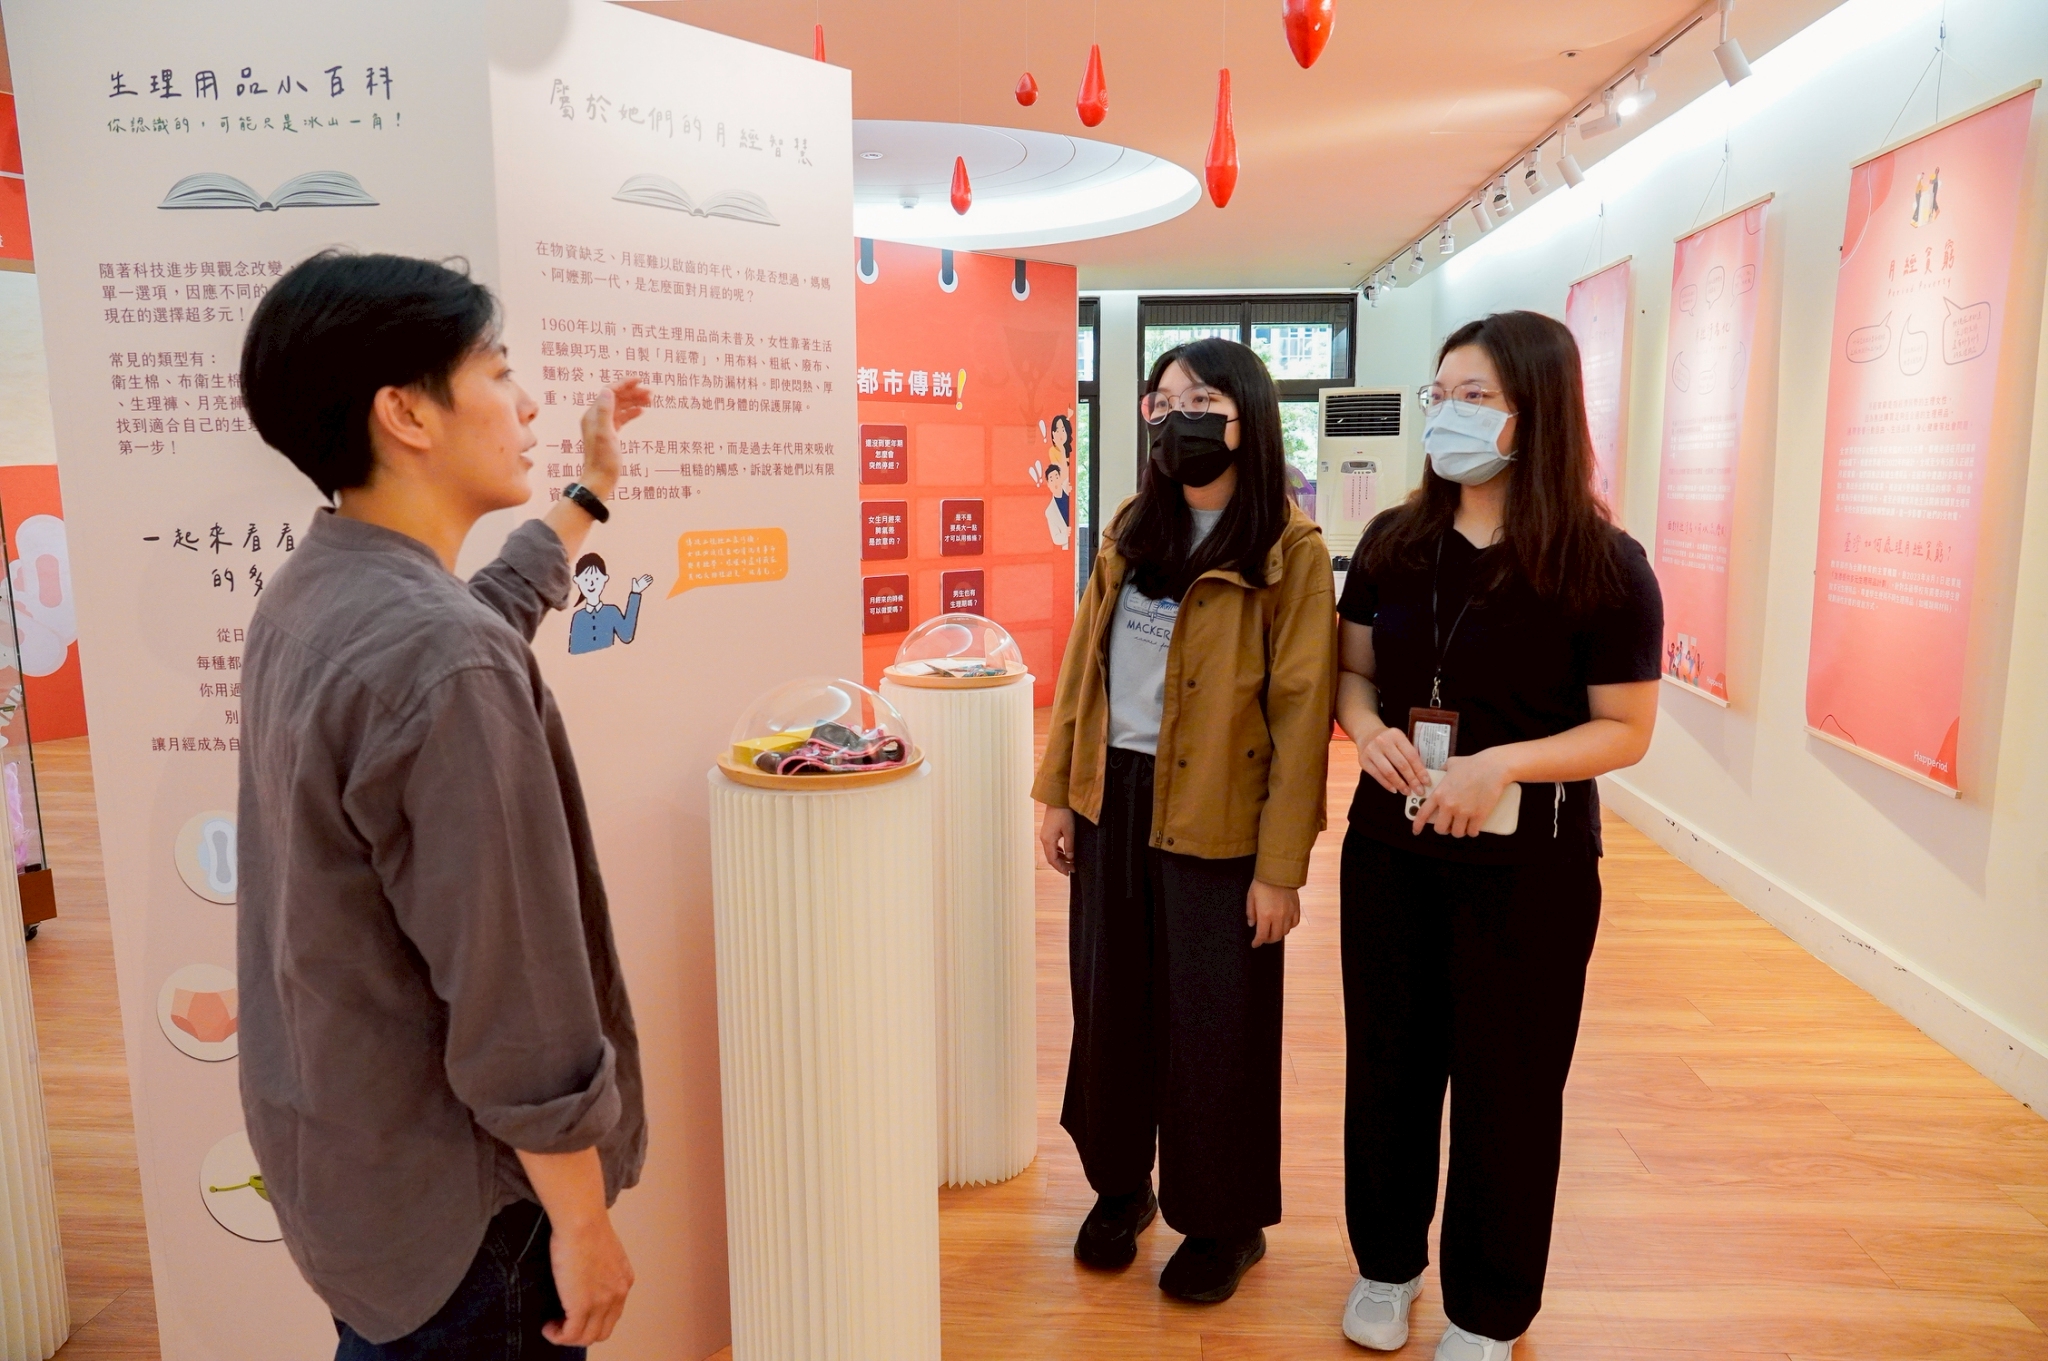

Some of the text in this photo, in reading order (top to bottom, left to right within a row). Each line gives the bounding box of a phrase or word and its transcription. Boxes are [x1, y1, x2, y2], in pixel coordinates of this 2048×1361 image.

[109, 65, 393, 100] 生理用品小百科
[550, 78, 812, 166] 屬於她們的月經智慧
[104, 307, 246, 323] 現在的選擇超多元！
[109, 351, 216, 368] 常見的類型有：
[118, 440, 176, 455] 第一步！
[868, 515, 901, 524] 女生月經來
[143, 522, 295, 554] 一起來看看
[953, 589, 975, 598] 男生也有
[225, 710, 239, 725] 別
[1914, 750, 1948, 773] Happeriod
